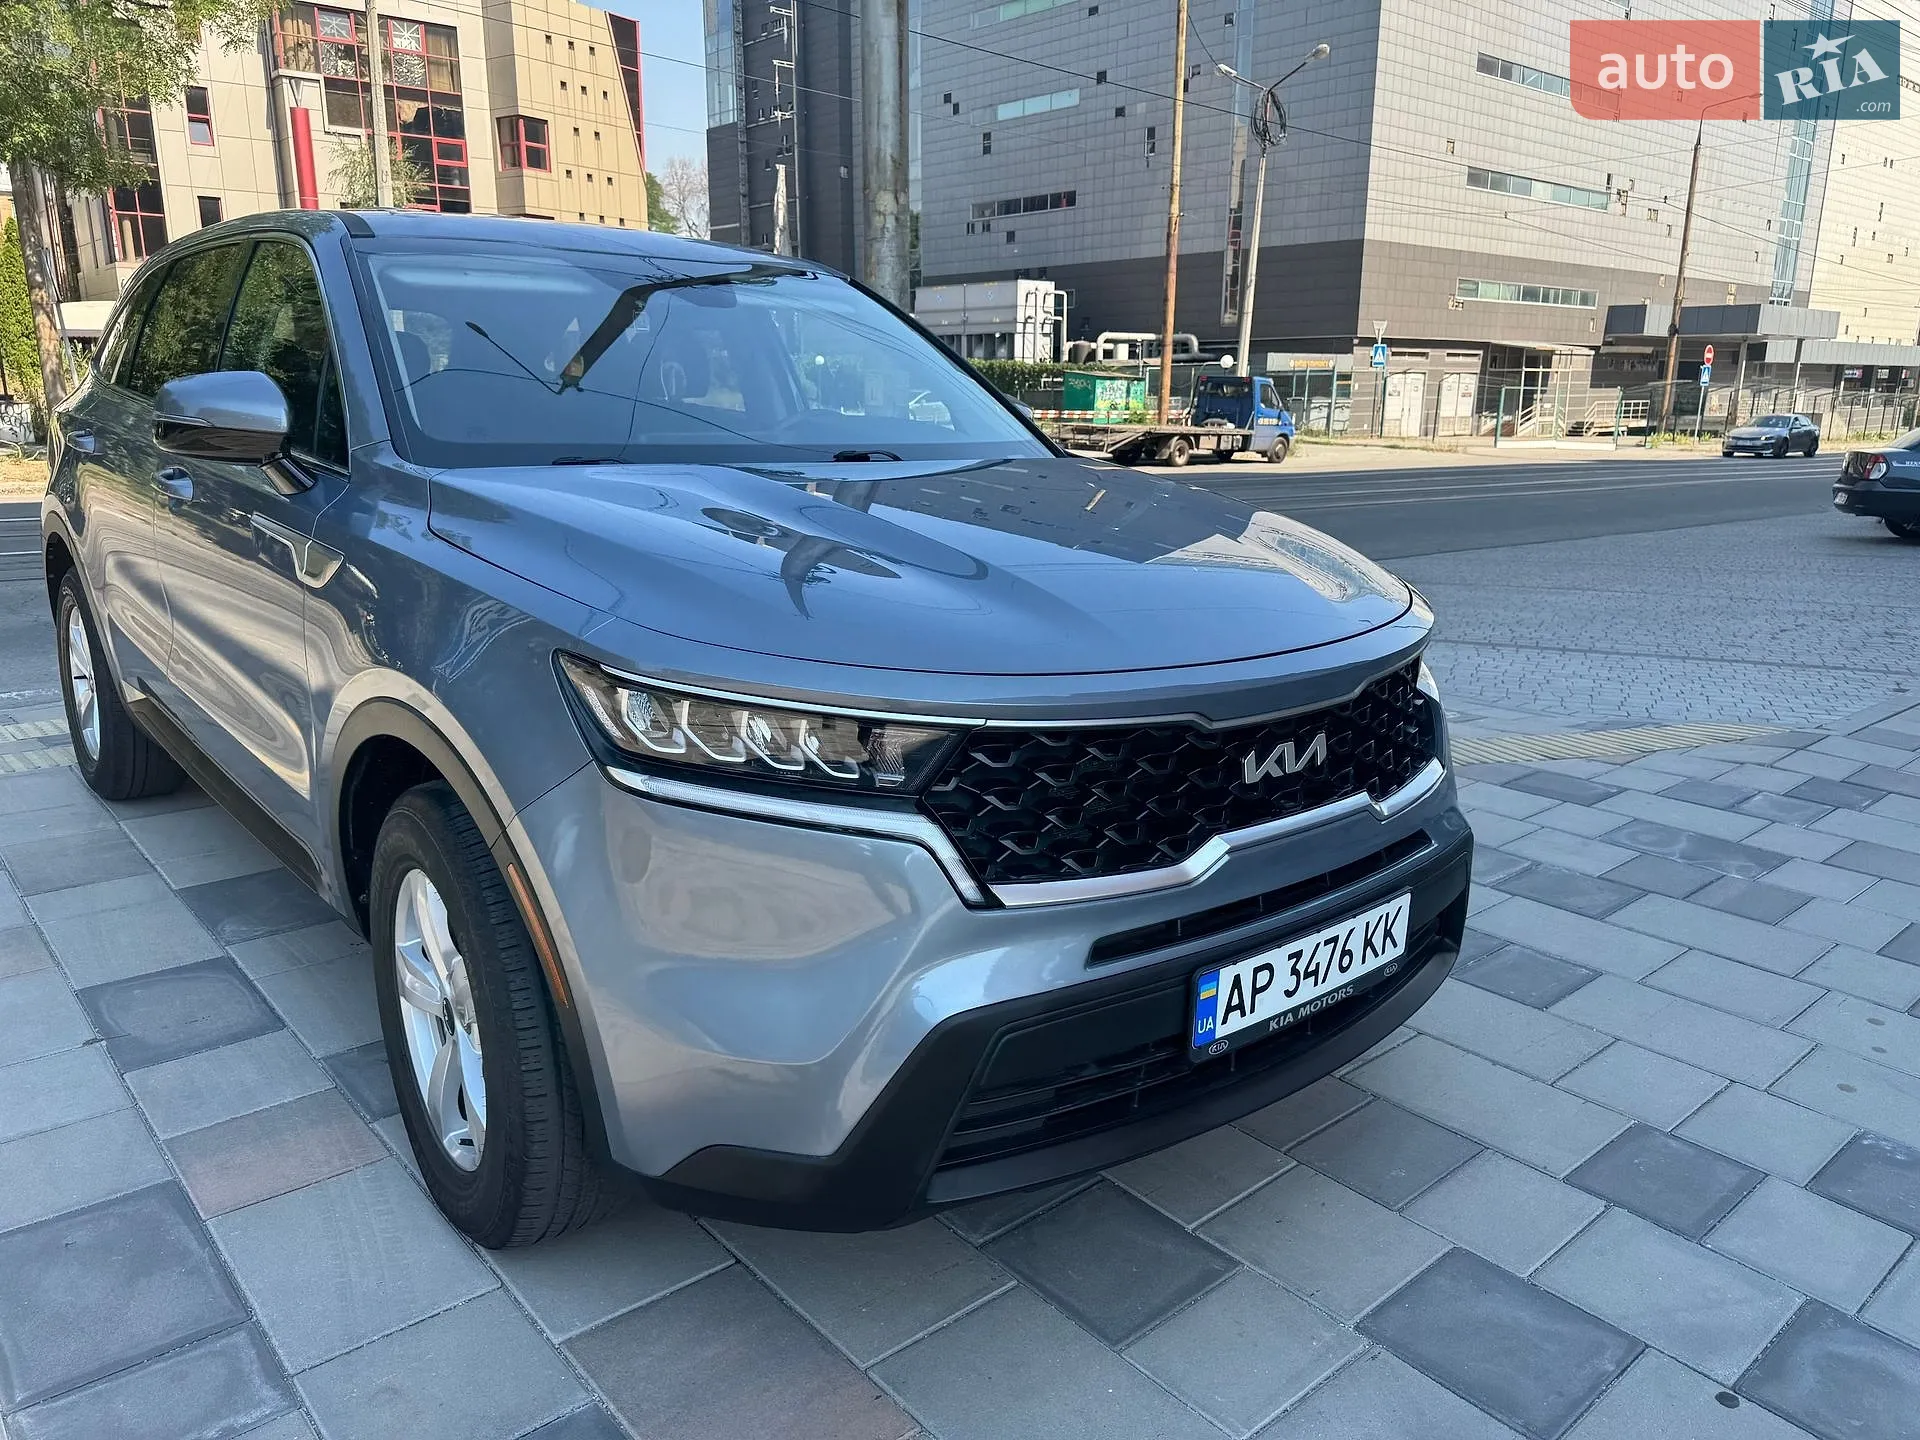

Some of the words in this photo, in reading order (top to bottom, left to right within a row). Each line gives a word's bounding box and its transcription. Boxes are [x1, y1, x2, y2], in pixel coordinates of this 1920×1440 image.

[1244, 730, 1327, 785] KIA
[1220, 962, 1275, 1026] AP
[1283, 926, 1356, 999] 3476
[1360, 905, 1403, 965] KK
[1197, 1015, 1215, 1034] UA
[1268, 1013, 1294, 1032] KIA
[1297, 985, 1355, 1018] MOTORS
[1211, 1041, 1226, 1053] KIA
